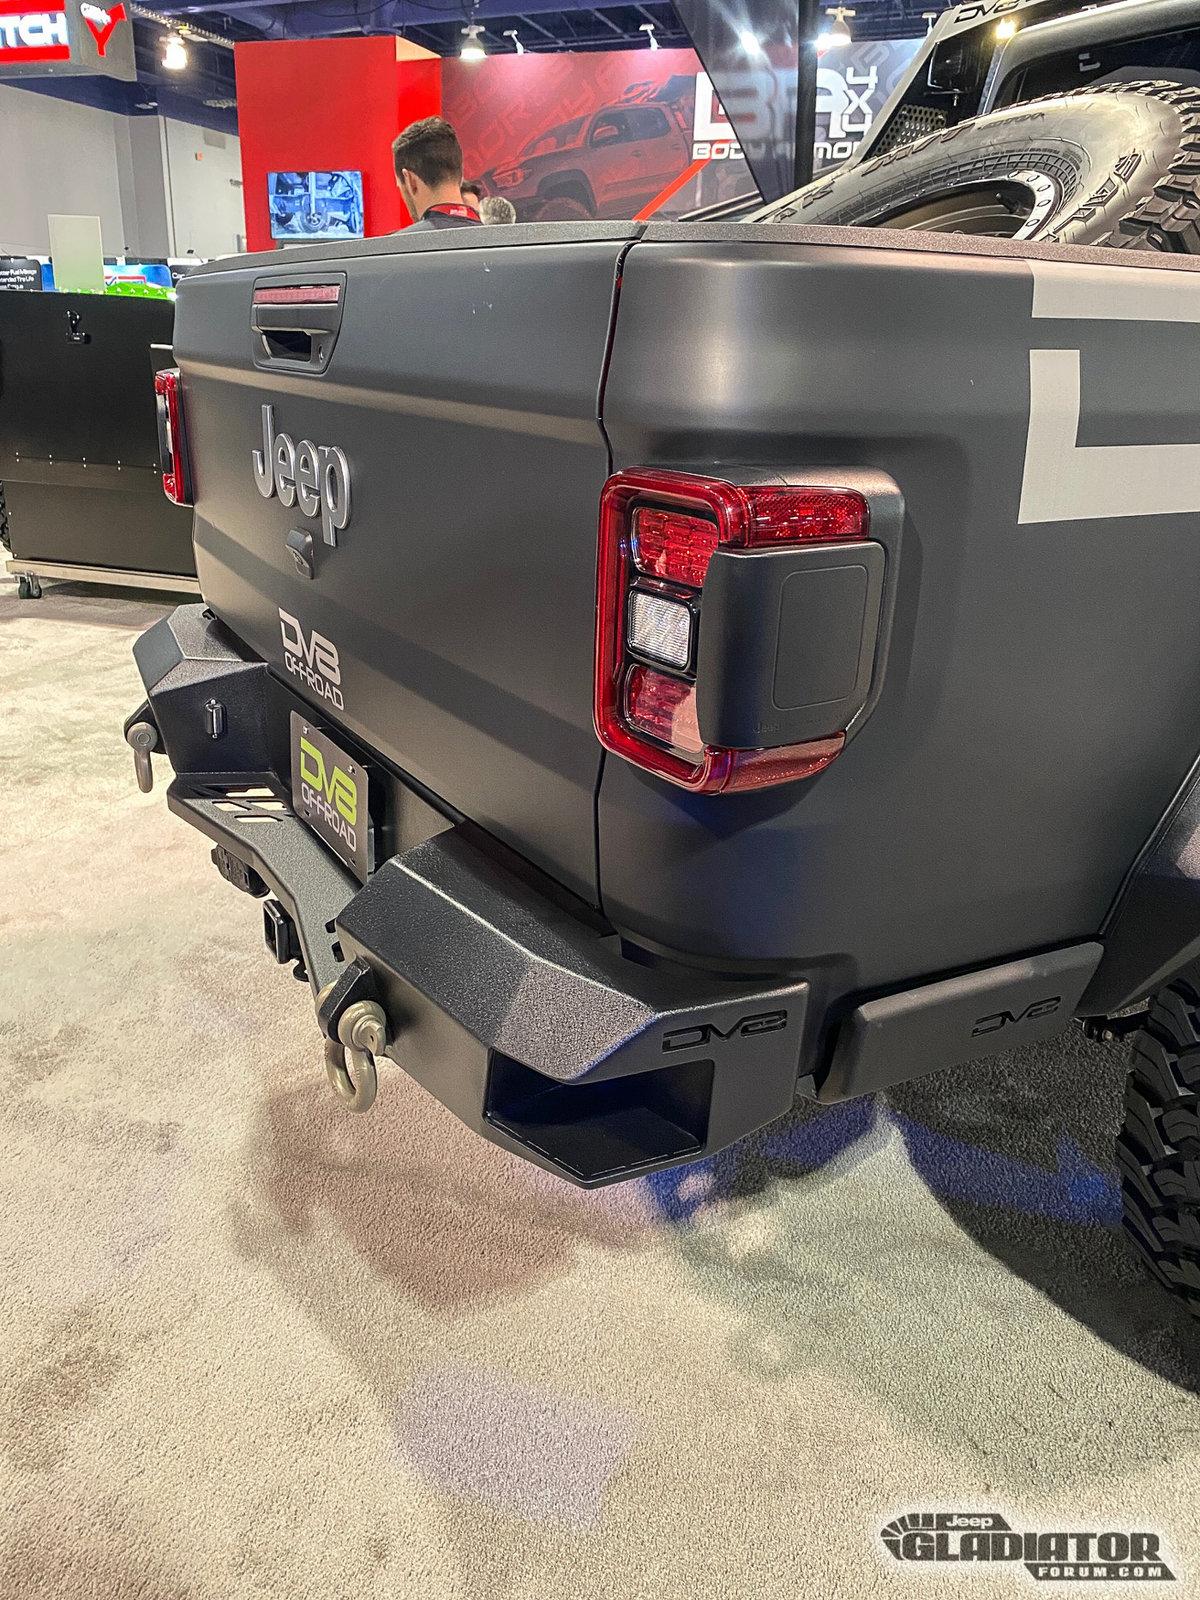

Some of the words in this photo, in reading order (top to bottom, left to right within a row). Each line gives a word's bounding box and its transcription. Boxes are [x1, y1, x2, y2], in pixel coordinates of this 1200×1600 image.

[0, 12, 68, 48] TCH
[252, 404, 351, 547] Jeep
[278, 607, 341, 685] DV8
[300, 736, 358, 826] DV8
[662, 1009, 788, 1053] DV8
[971, 996, 1061, 1038] DV8
